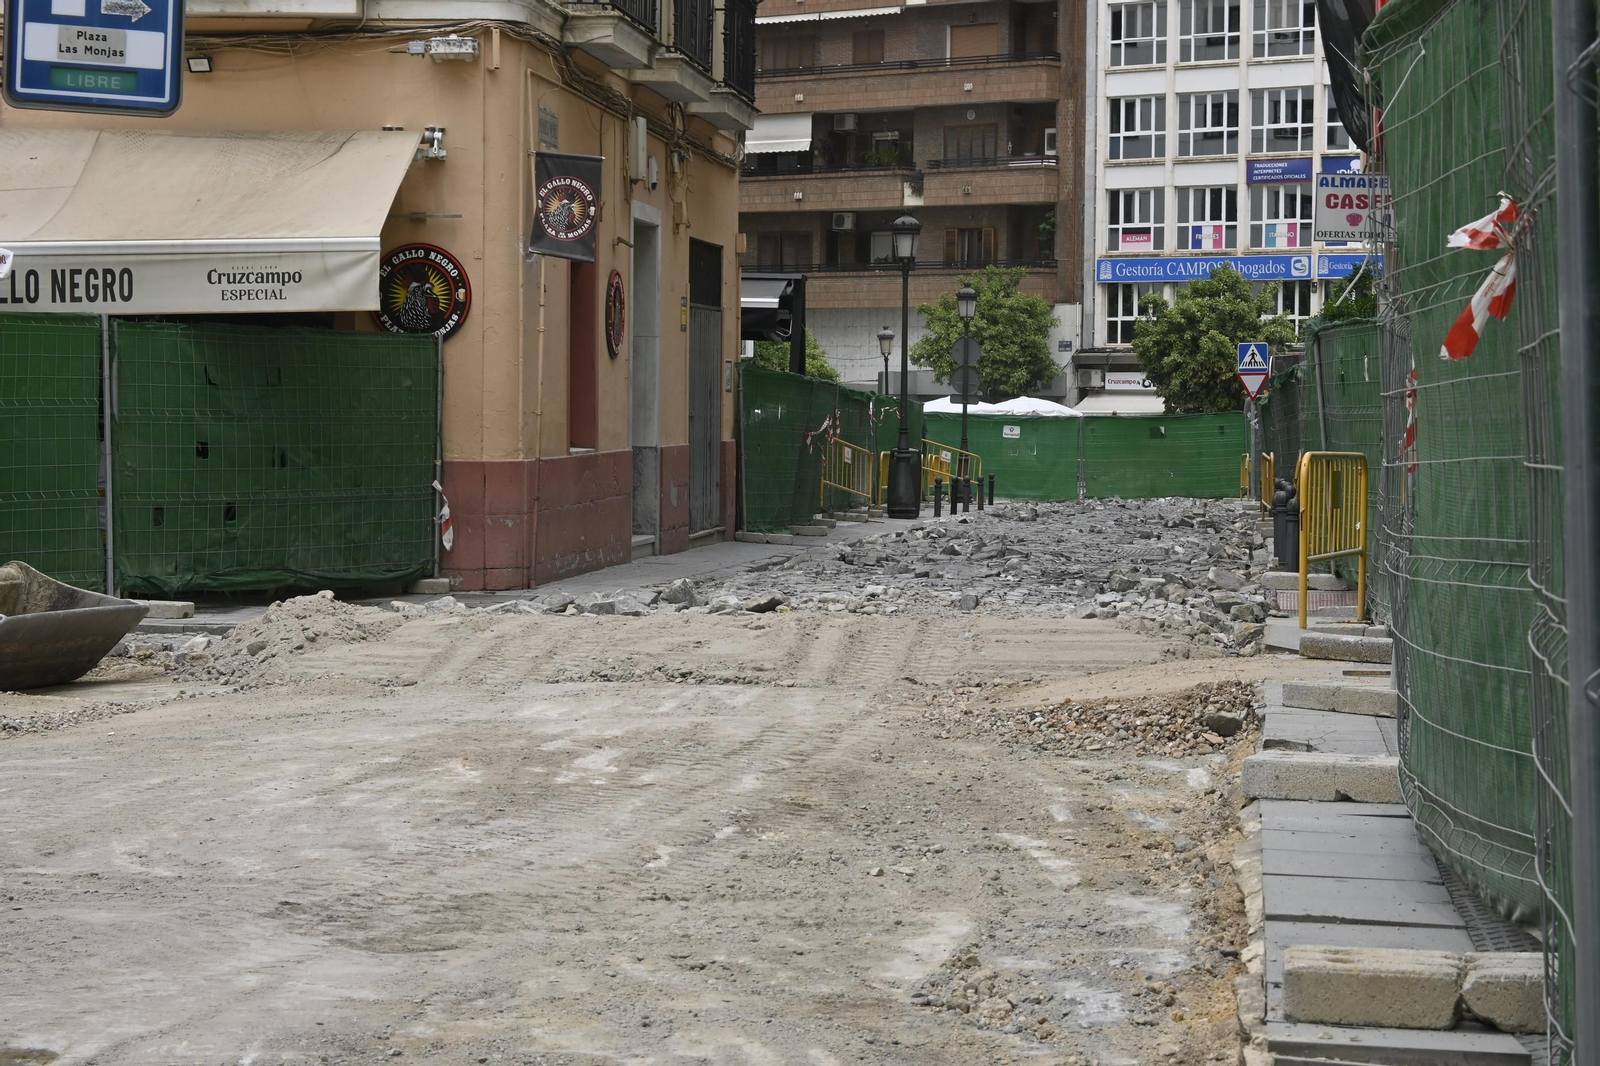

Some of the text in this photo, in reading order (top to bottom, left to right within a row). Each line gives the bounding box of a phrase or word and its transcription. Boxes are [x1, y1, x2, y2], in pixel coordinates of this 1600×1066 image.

[76, 30, 108, 42] Plaza
[58, 43, 125, 58] Las Monjas
[66, 73, 122, 90] LIBRE
[539, 178, 593, 201] EL GALLO NEGRO
[567, 218, 592, 238] MONJAS
[1316, 230, 1356, 239] OFERTAS
[392, 249, 425, 264] GALLO
[428, 251, 459, 277] NEGRO
[1116, 262, 1163, 277] Gestoría
[1229, 259, 1286, 278] Abogados
[51, 267, 134, 303] NEGRO
[206, 268, 303, 287] Cruzcampo
[221, 288, 287, 301] ESPECIAL
[432, 313, 459, 337] ONJAS
[1107, 378, 1137, 386] Cruzcampo
